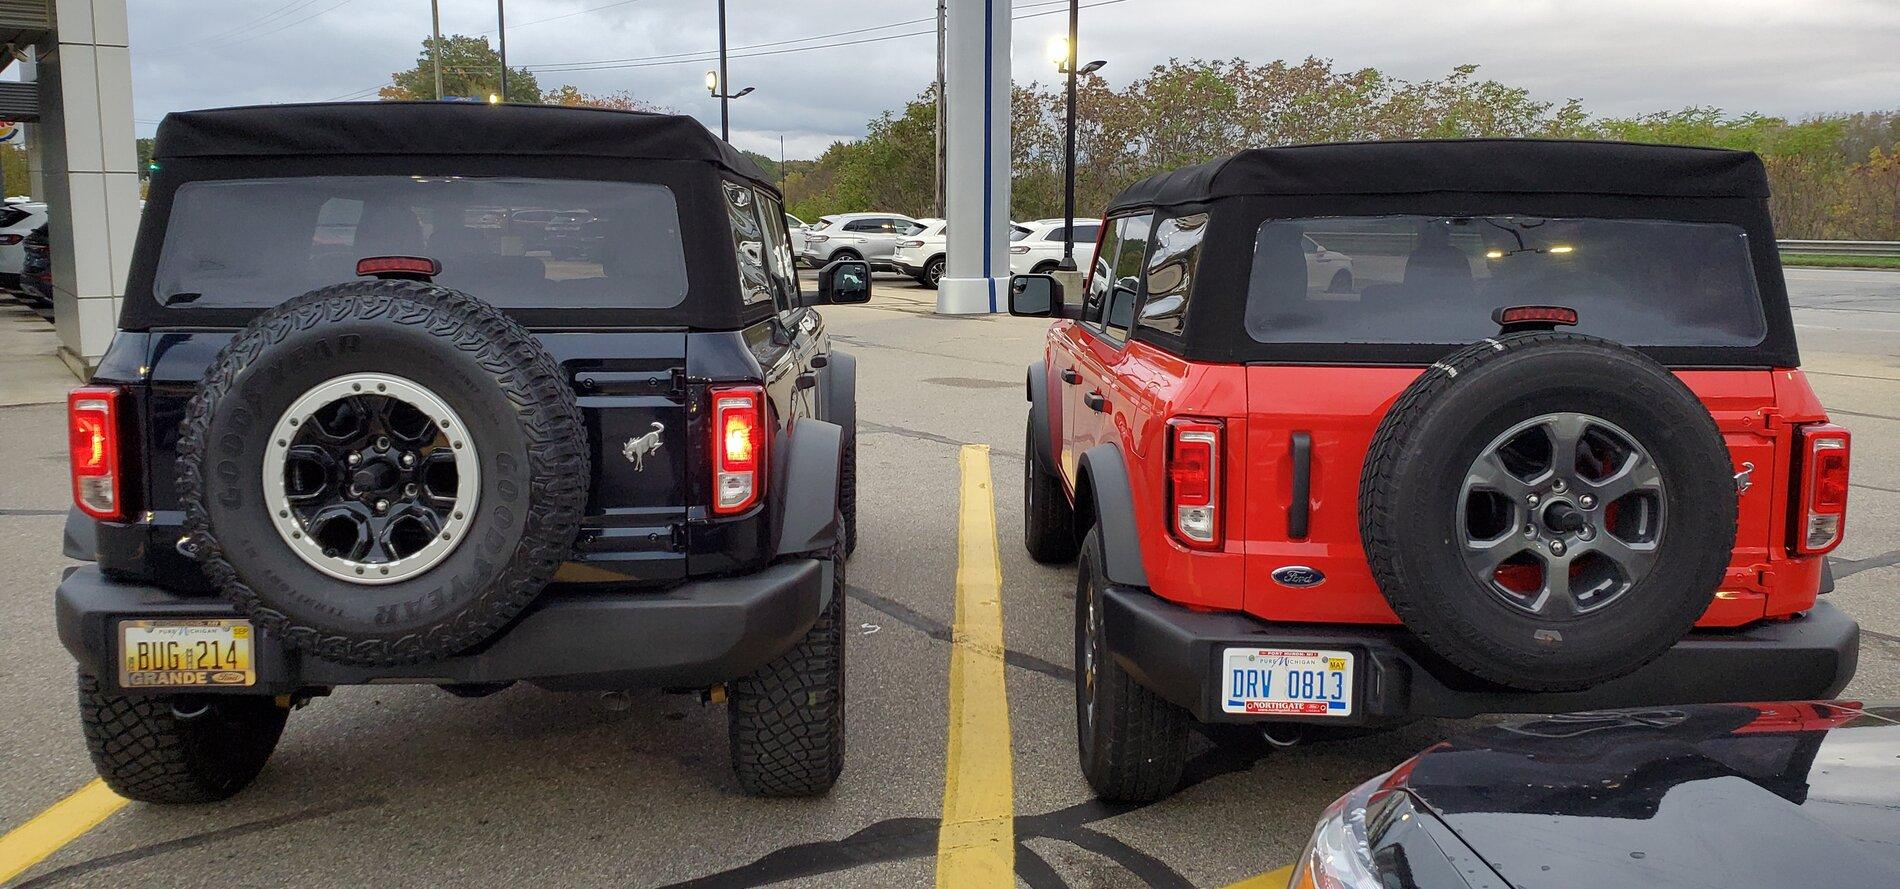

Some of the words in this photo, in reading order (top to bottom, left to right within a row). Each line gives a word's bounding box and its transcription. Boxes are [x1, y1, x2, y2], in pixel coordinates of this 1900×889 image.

[1284, 570, 1314, 583] Ford
[159, 628, 176, 637] PURE
[177, 626, 218, 636] MICHIGAN
[233, 627, 249, 635] SEP
[137, 641, 180, 671] BUG
[196, 640, 238, 670] 214
[1260, 658, 1278, 667] PURE
[1278, 656, 1316, 667] MICHIGAN
[1329, 661, 1346, 669] MAY
[128, 671, 208, 685] GRANDE
[1232, 669, 1273, 698] DRV
[1288, 670, 1343, 700] 0813
[1253, 701, 1305, 709] NORTHGATE
